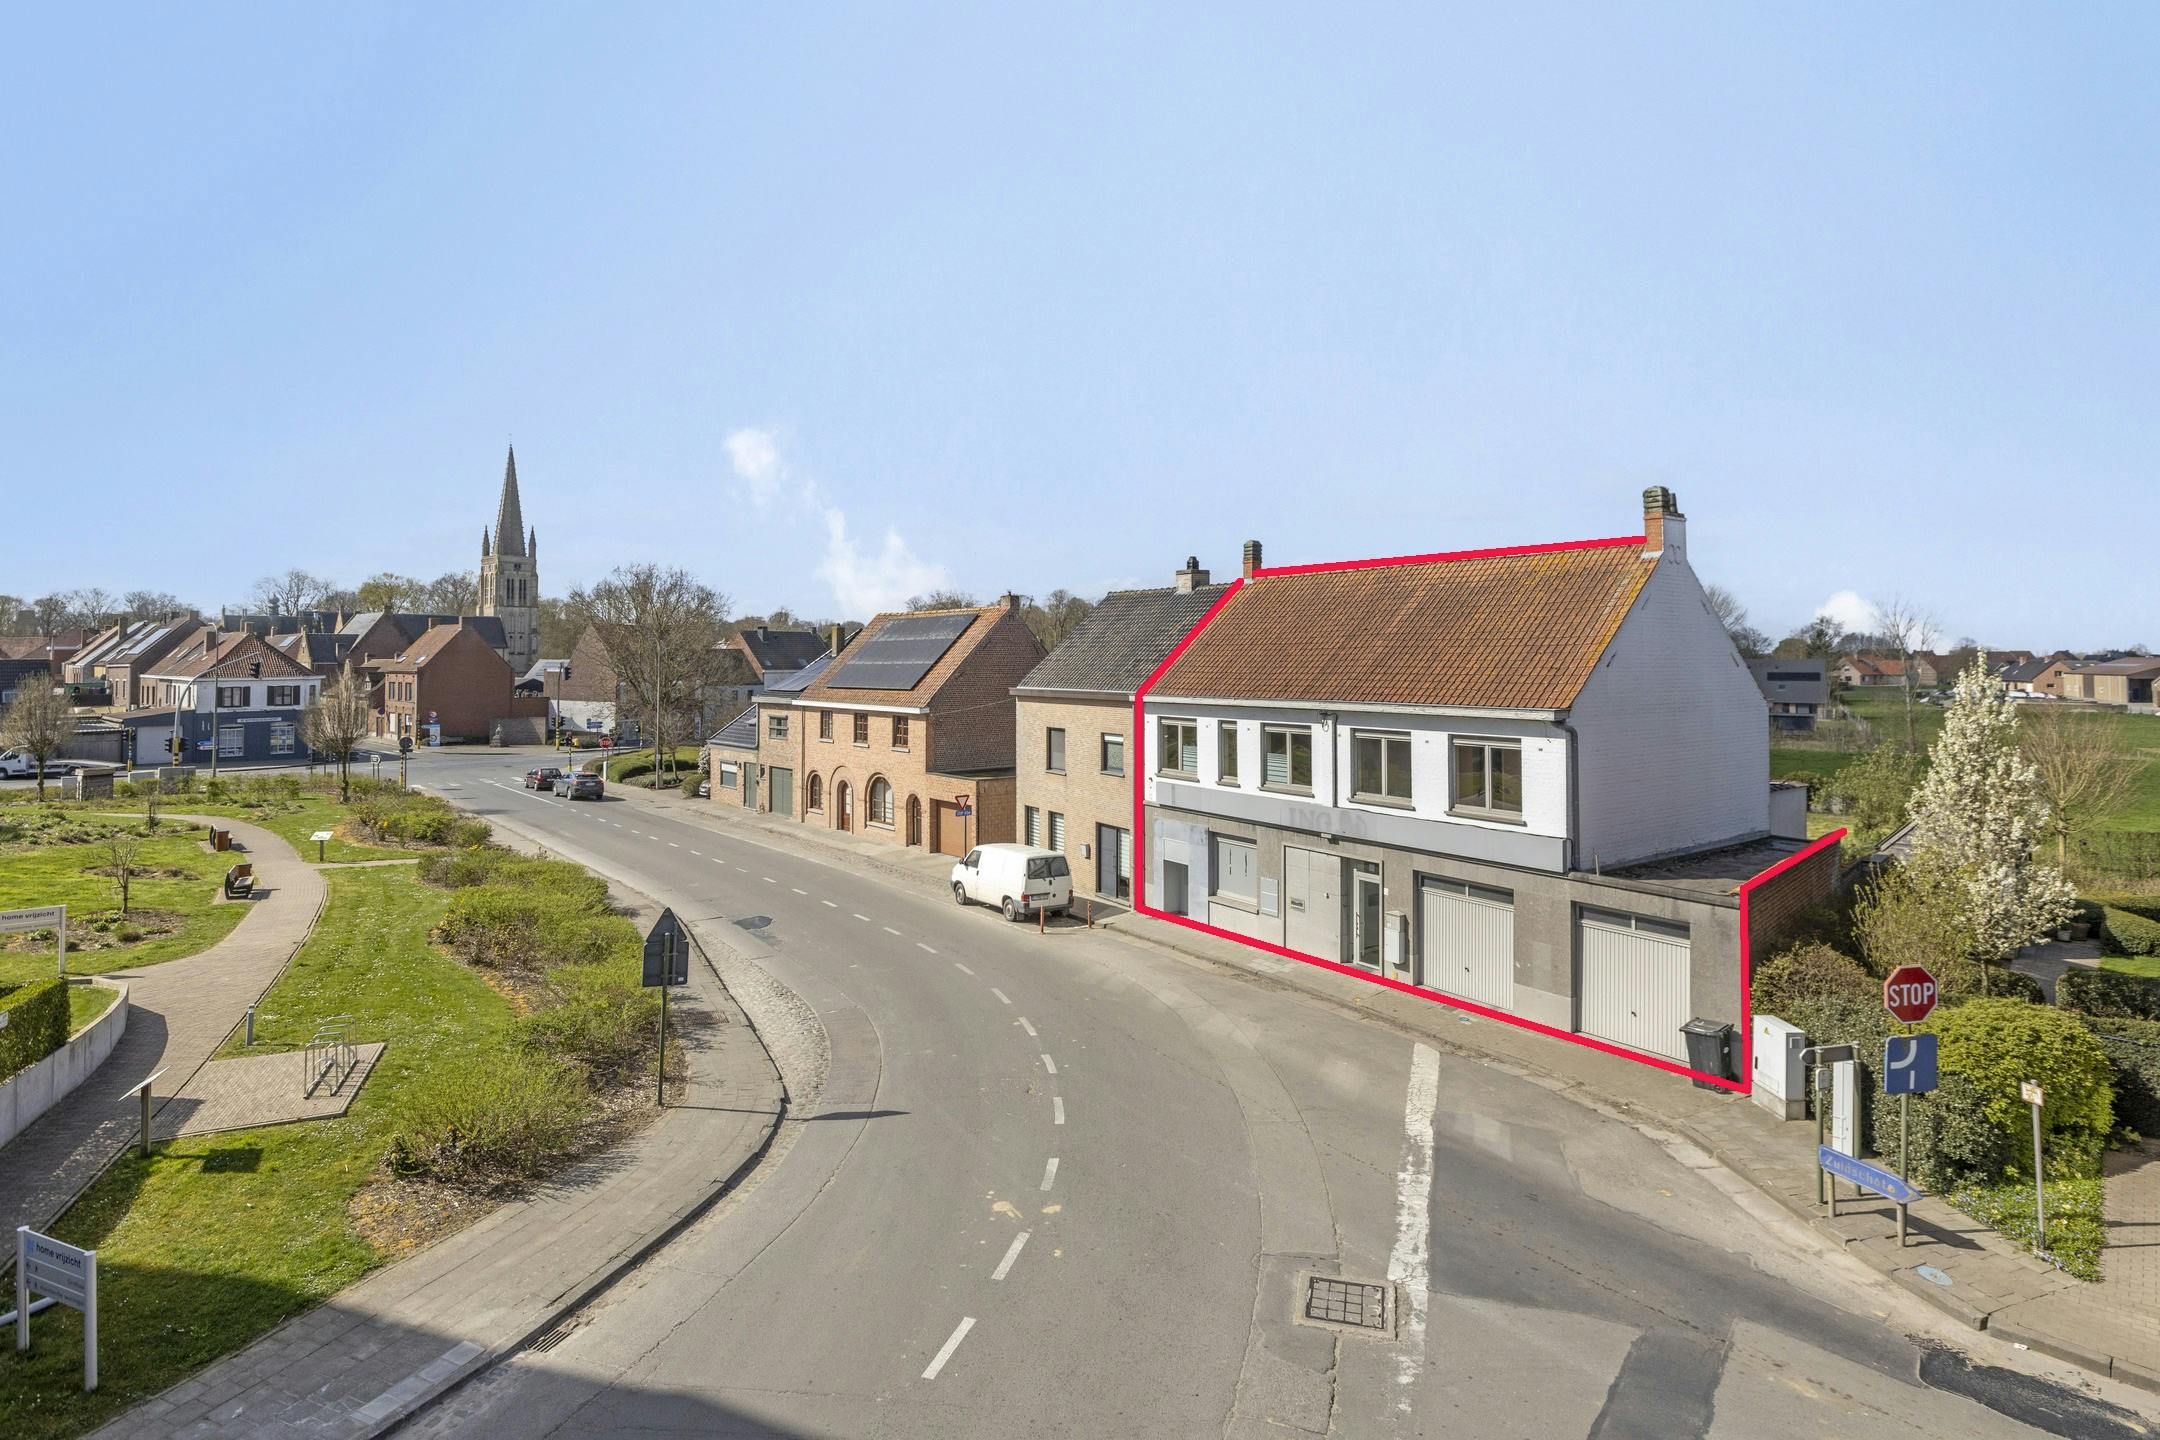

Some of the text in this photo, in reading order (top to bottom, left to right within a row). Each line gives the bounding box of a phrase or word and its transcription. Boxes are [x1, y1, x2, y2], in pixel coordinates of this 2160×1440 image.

[25, 911, 55, 919] vrijzicht
[1889, 982, 1934, 1007] STOP
[36, 1242, 81, 1269] home vrijzicht
